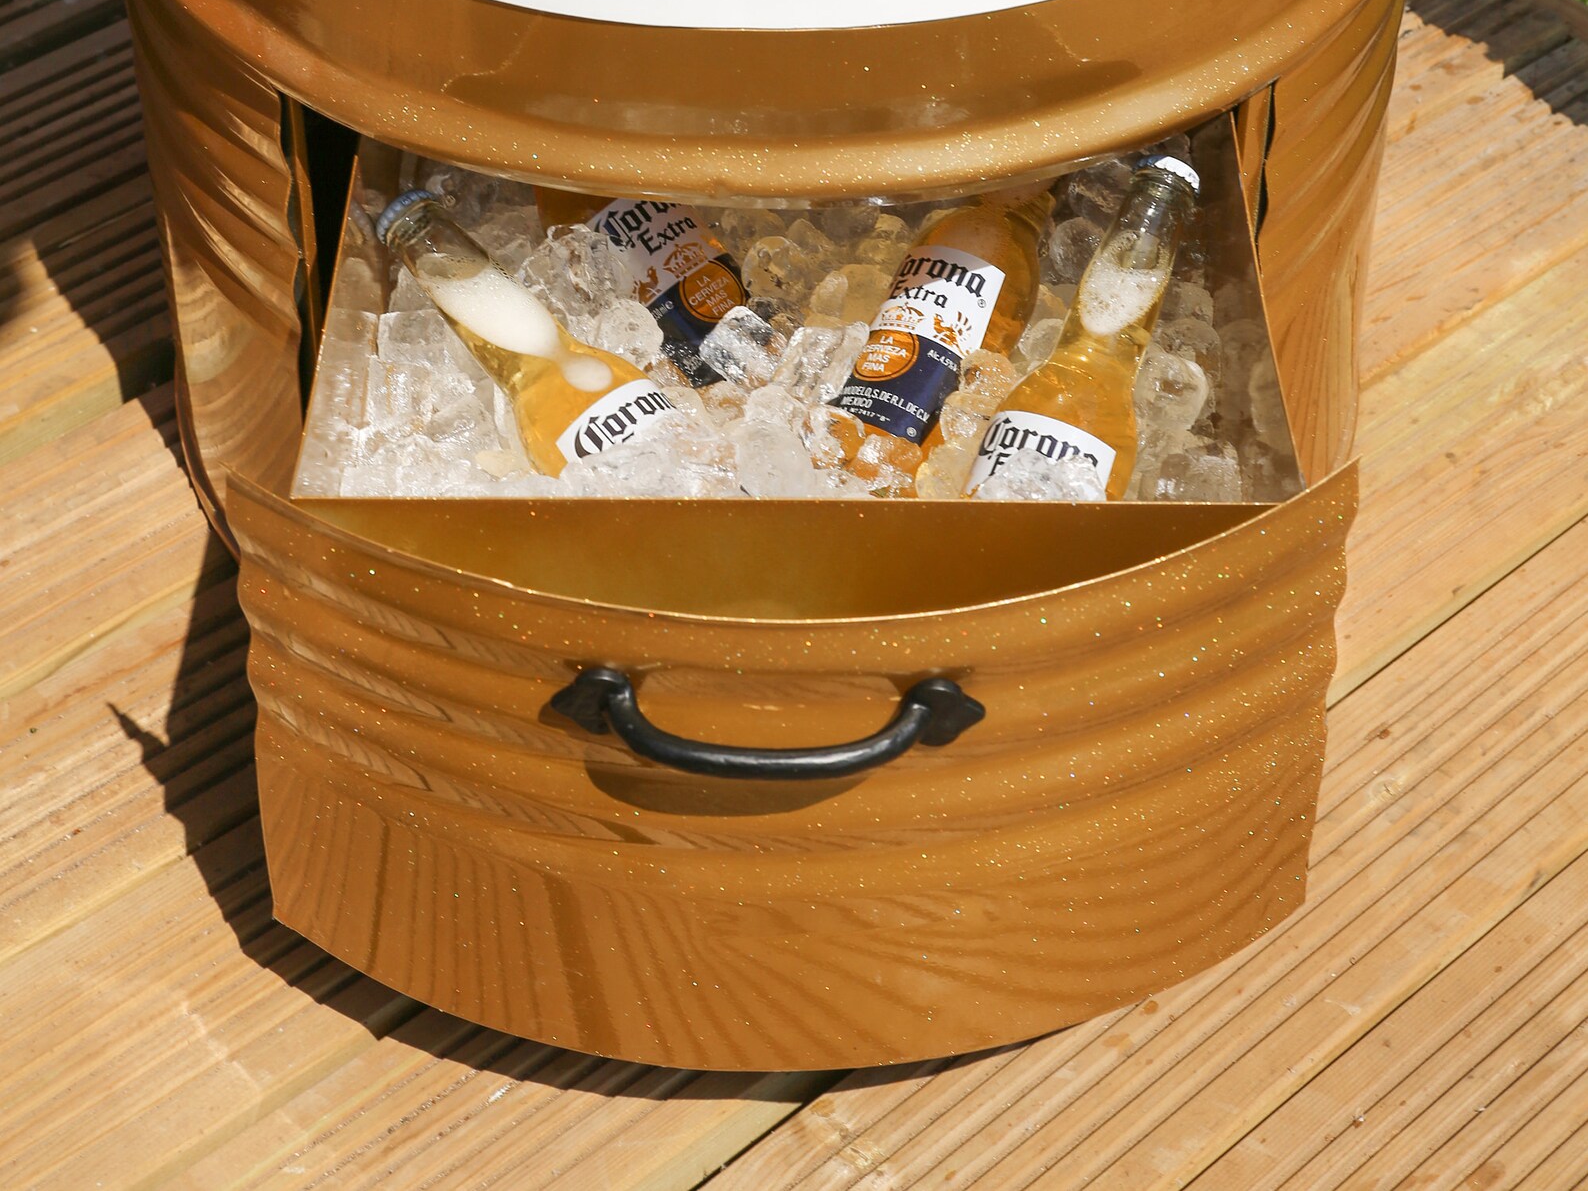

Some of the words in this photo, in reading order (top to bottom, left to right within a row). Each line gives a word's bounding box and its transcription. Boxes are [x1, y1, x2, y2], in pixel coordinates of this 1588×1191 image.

[637, 216, 697, 256] Extra
[696, 275, 711, 287] LA
[689, 276, 729, 306] CERVEZA
[706, 289, 728, 307] MAS
[888, 279, 949, 308] Extra
[711, 299, 735, 316] FINA
[880, 335, 894, 344] LA
[861, 362, 885, 372] FINA
[867, 353, 891, 364] MAS
[574, 391, 677, 459] Coron
